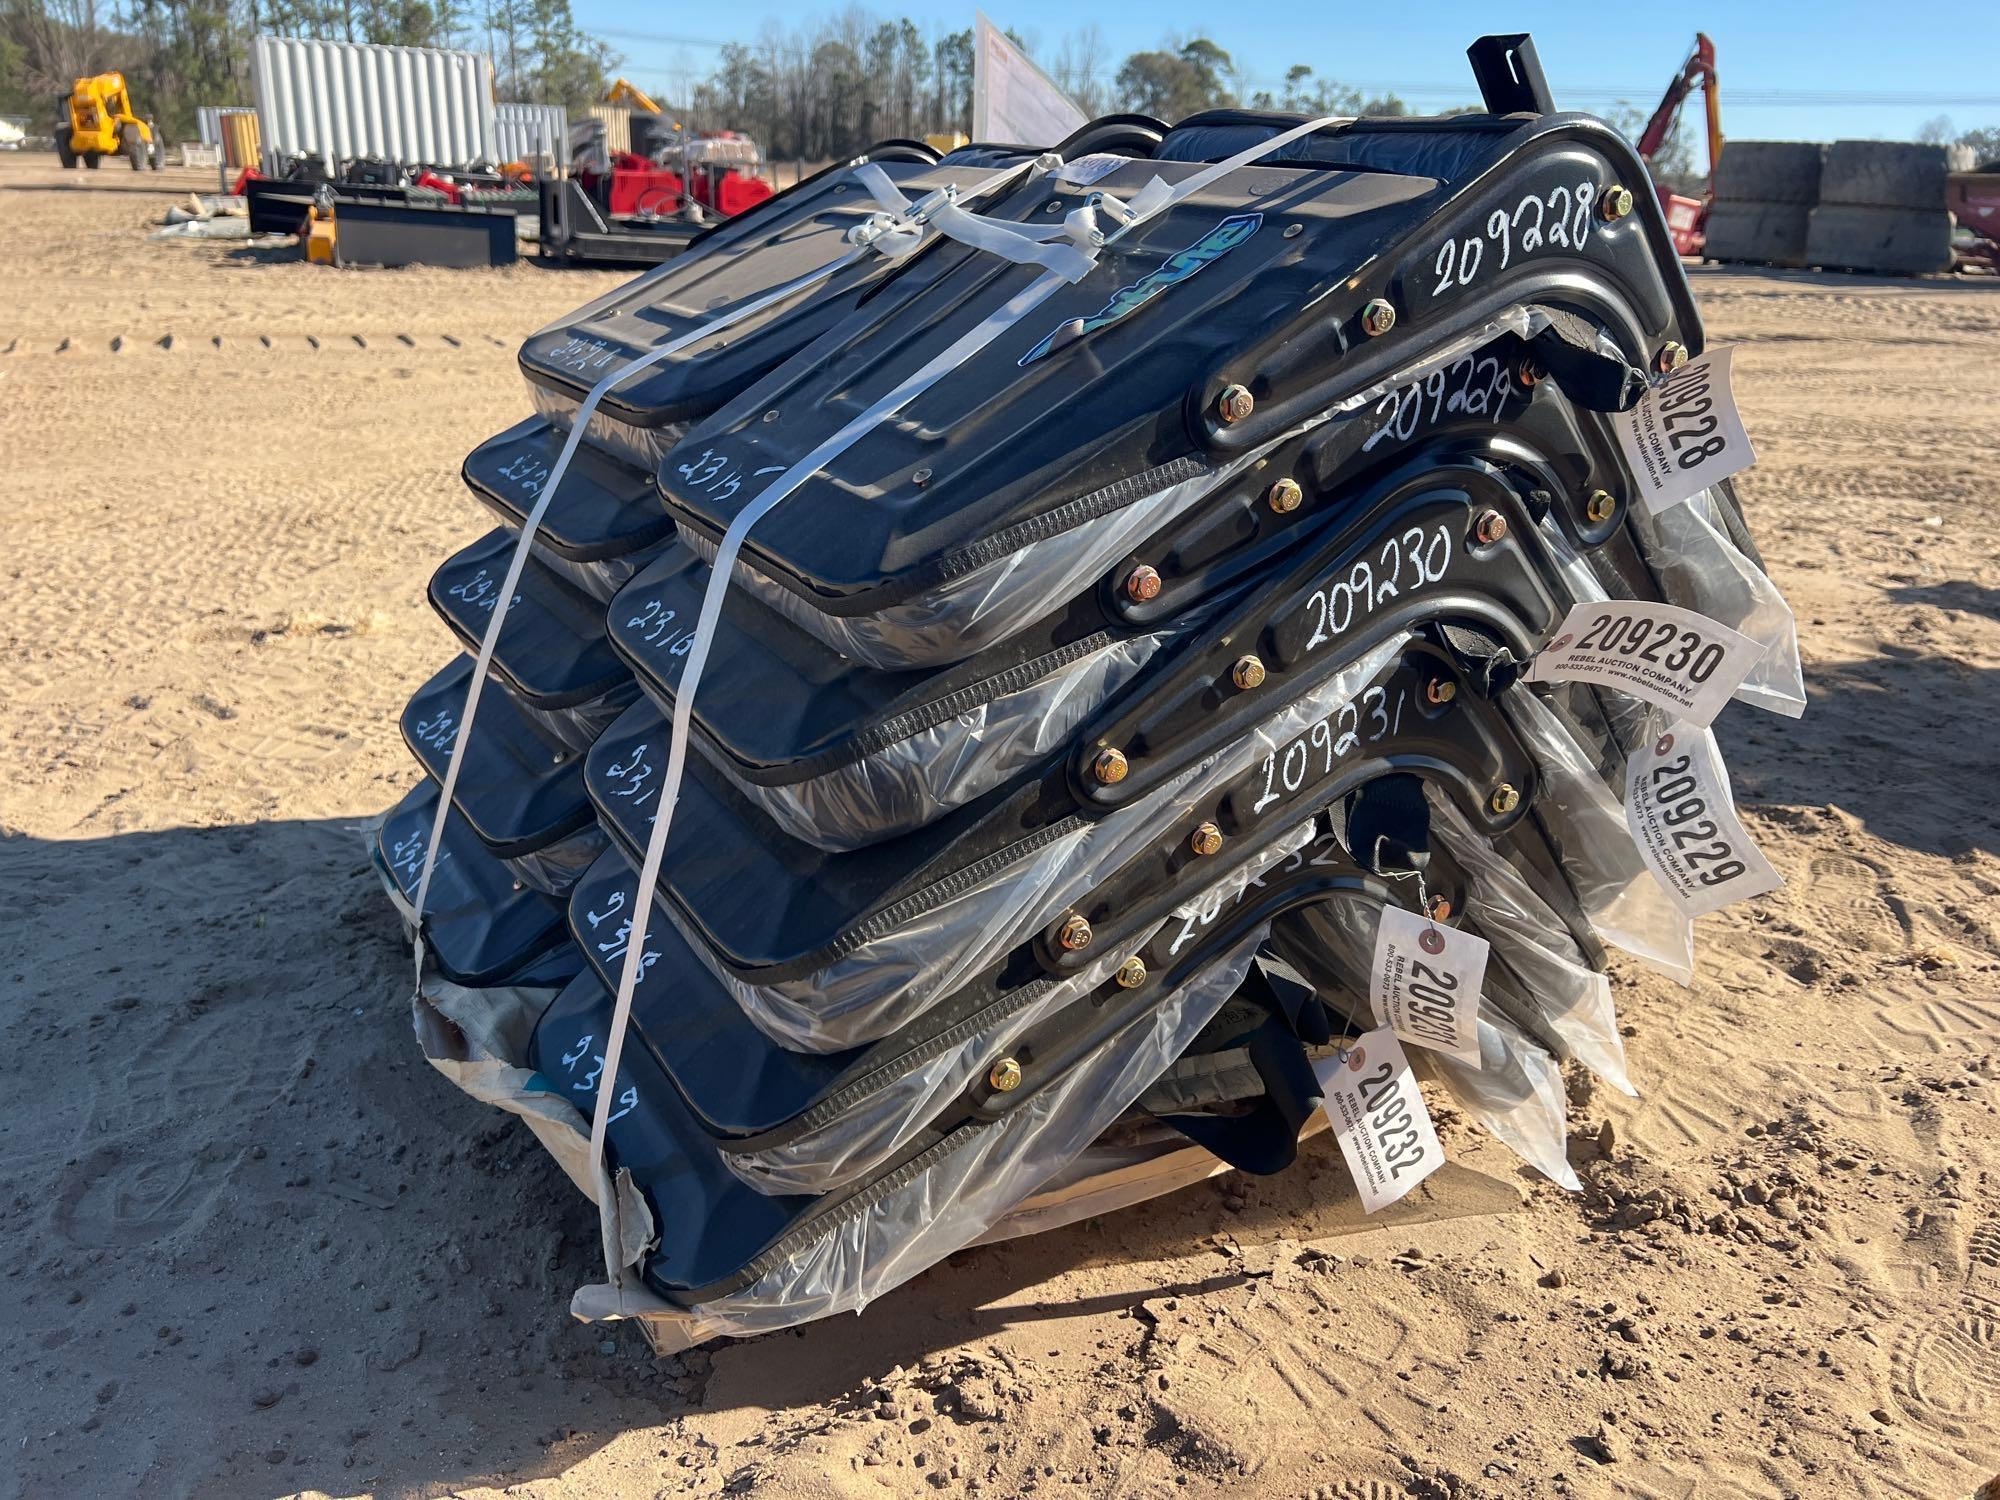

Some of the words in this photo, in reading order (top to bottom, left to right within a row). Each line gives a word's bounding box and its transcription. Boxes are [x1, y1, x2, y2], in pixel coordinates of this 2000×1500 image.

[1432, 178, 1595, 296] 209228
[1362, 354, 1512, 452] 209229
[1642, 403, 1655, 433] AUCTION
[1649, 433, 1672, 475] COMPANY
[1659, 363, 1726, 470] 209228
[1631, 419, 1663, 490] www.rebelauction.net
[1306, 525, 1451, 651] 209230
[1568, 654, 1596, 664] REBEL
[1598, 657, 1641, 672] AUCTION
[1642, 667, 1693, 695] COMPANY
[1575, 615, 1725, 683] 209230
[1607, 668, 1694, 708] www.rebelauction.net
[1254, 686, 1405, 814] 209231
[1641, 776, 1649, 805] REBEL
[1645, 806, 1666, 847] AUCTION
[1663, 848, 1696, 890] COMPANY
[1641, 824, 1691, 899] www.rebelauction.net
[1653, 755, 1746, 886] 209229
[1382, 944, 1395, 990] 800-533-0673
[1394, 955, 1405, 984] REBEL
[1407, 960, 1460, 1048] 209231
[1347, 1092, 1360, 1118] REBEL
[1356, 1118, 1372, 1152] AUCTION
[1369, 1150, 1387, 1184] COMPANY
[1358, 1062, 1425, 1180] 209232
[1352, 1136, 1379, 1195] www.rebelauction.net
